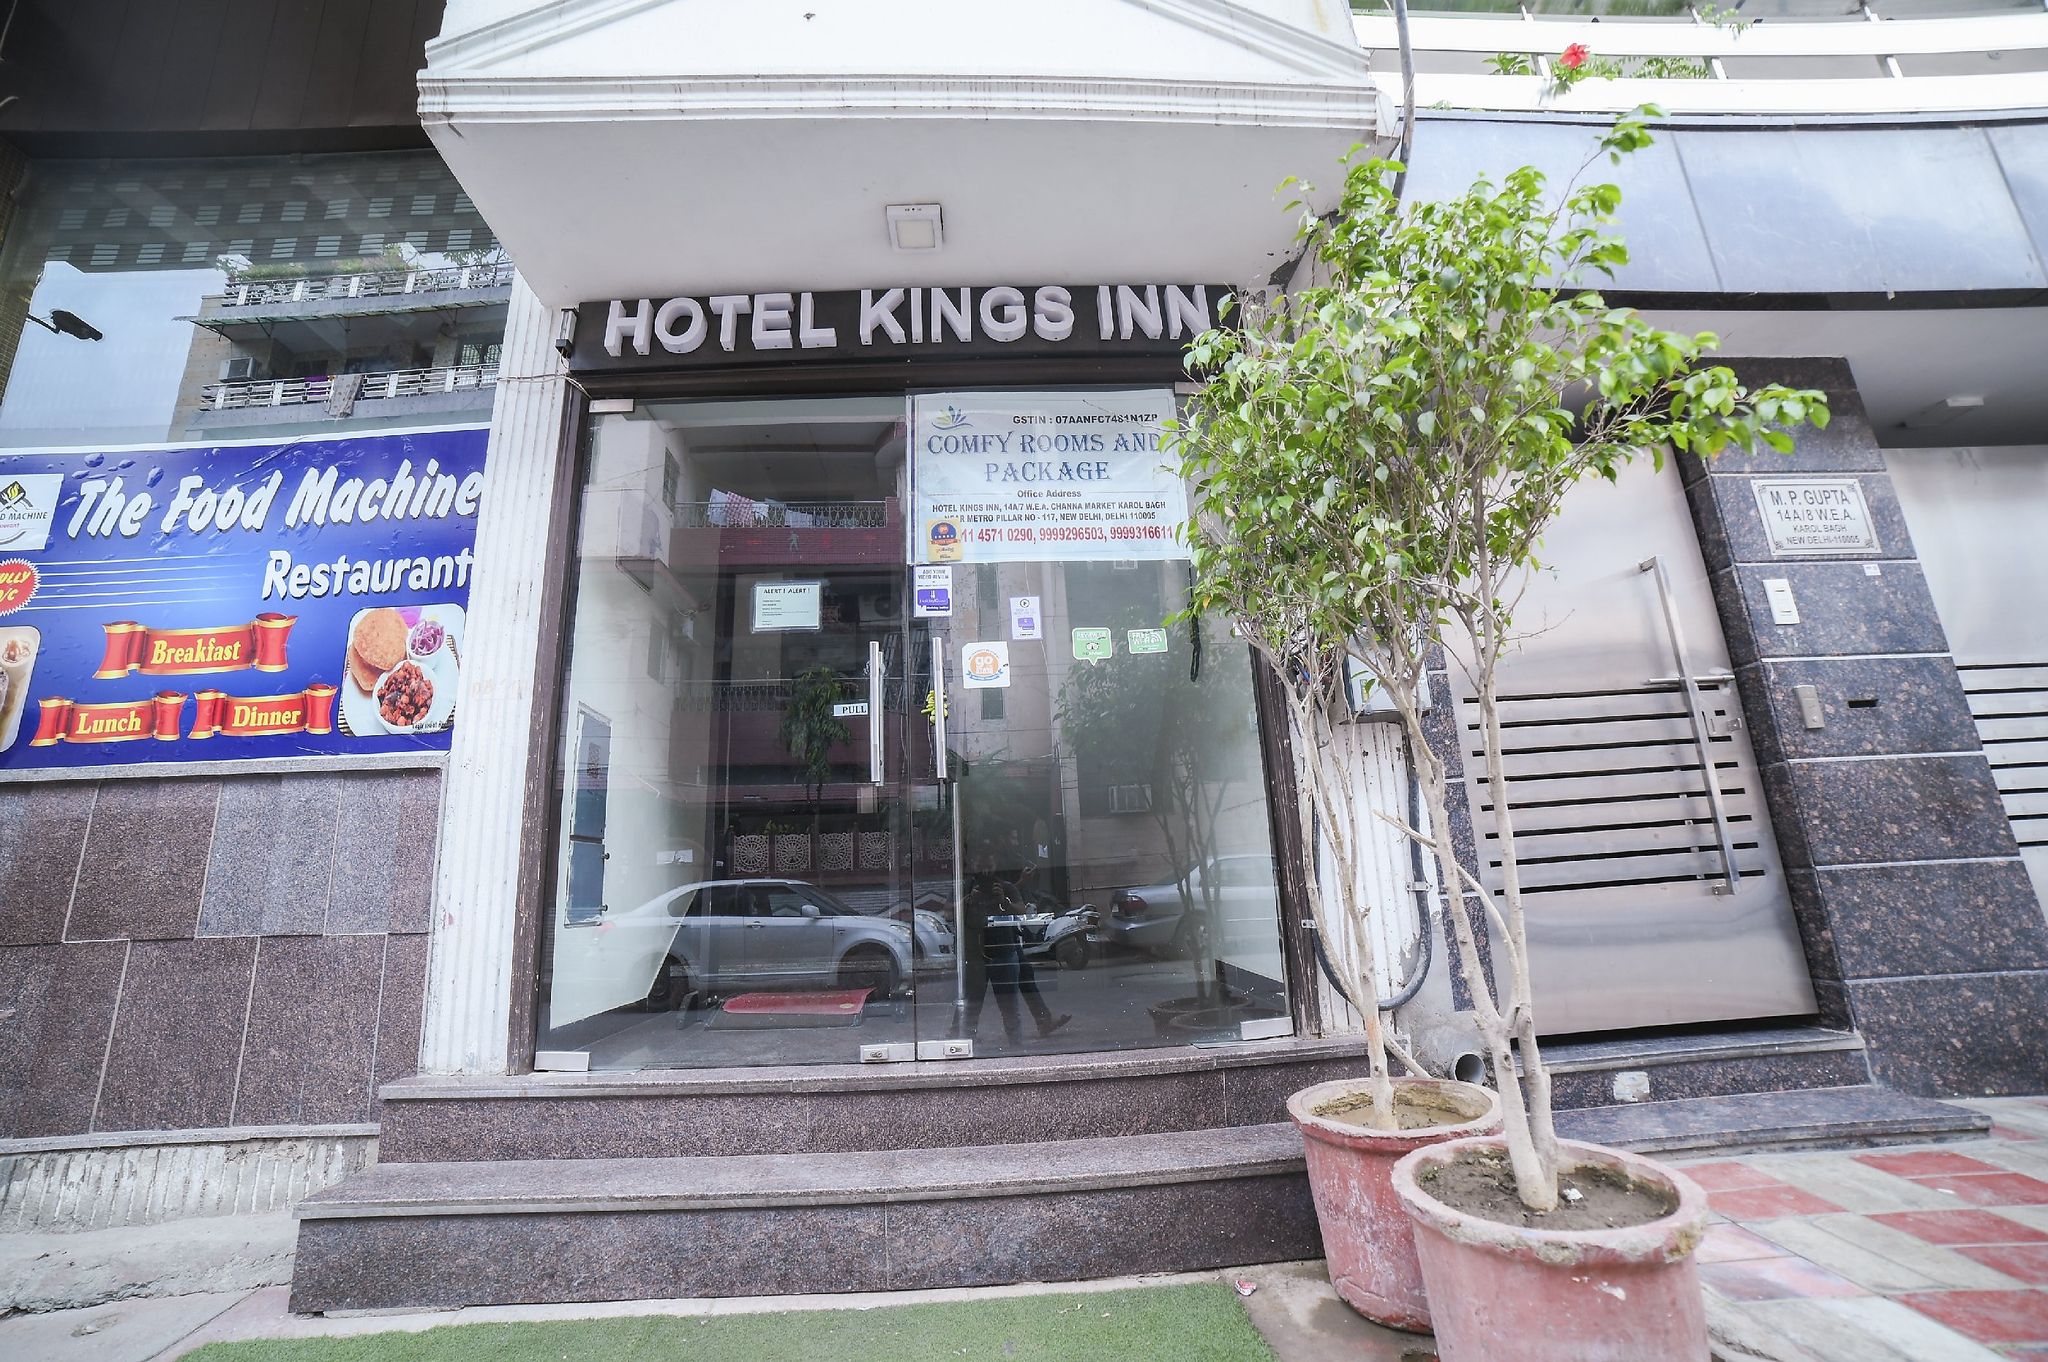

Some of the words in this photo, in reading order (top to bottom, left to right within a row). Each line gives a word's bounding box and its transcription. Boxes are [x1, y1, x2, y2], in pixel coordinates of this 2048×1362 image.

[603, 291, 836, 357] HOTEL
[859, 285, 1075, 345] KINGS
[1098, 284, 1212, 340] INN
[1012, 415, 1046, 424] GSTIN
[927, 430, 1015, 455] COMFY
[1019, 432, 1104, 454] ROOMS
[1113, 432, 1162, 453] AND
[984, 460, 1112, 482] PACKAGE
[67, 474, 153, 539] The
[160, 469, 283, 535] Food
[285, 458, 483, 530] Machine
[1017, 489, 1044, 498] Office
[1046, 488, 1082, 498] Address
[1770, 490, 1787, 506] M.
[1788, 490, 1802, 506] P.
[1803, 489, 1851, 505] GUPTA
[932, 503, 957, 513] HOTEL
[960, 503, 984, 512] KINGS
[985, 502, 1002, 513] INN,
[1026, 502, 1049, 511] W.E.A.
[1051, 502, 1083, 511] CHANNA
[1085, 501, 1116, 510] MARKET
[1118, 501, 1144, 510] KAROL
[1145, 500, 1166, 509] BAGH
[1777, 508, 1814, 521] 14A/8
[1815, 508, 1856, 521] W.E.A.
[8, 511, 48, 520] MACHINE
[967, 513, 994, 523] METRO
[996, 513, 1023, 523] PILLAR
[1025, 513, 1036, 522] NO
[1042, 512, 1058, 523] 117,
[1060, 512, 1077, 521] NEW
[1079, 512, 1104, 522] DELHI,
[1105, 511, 1128, 521] DELHI
[977, 527, 1003, 543] 4571
[1007, 527, 1036, 545] 0290,
[1039, 526, 1107, 545] 9999296503,
[1110, 525, 1173, 540] 9999316611
[1793, 524, 1822, 533] KAROL
[1823, 524, 1847, 533] BAGH
[1786, 536, 1806, 545] NEW
[261, 547, 476, 602] Restaurant
[150, 637, 241, 667] Breakfast
[231, 704, 302, 728] Dinner
[842, 705, 867, 714] PULL
[75, 711, 142, 737] Lunch
